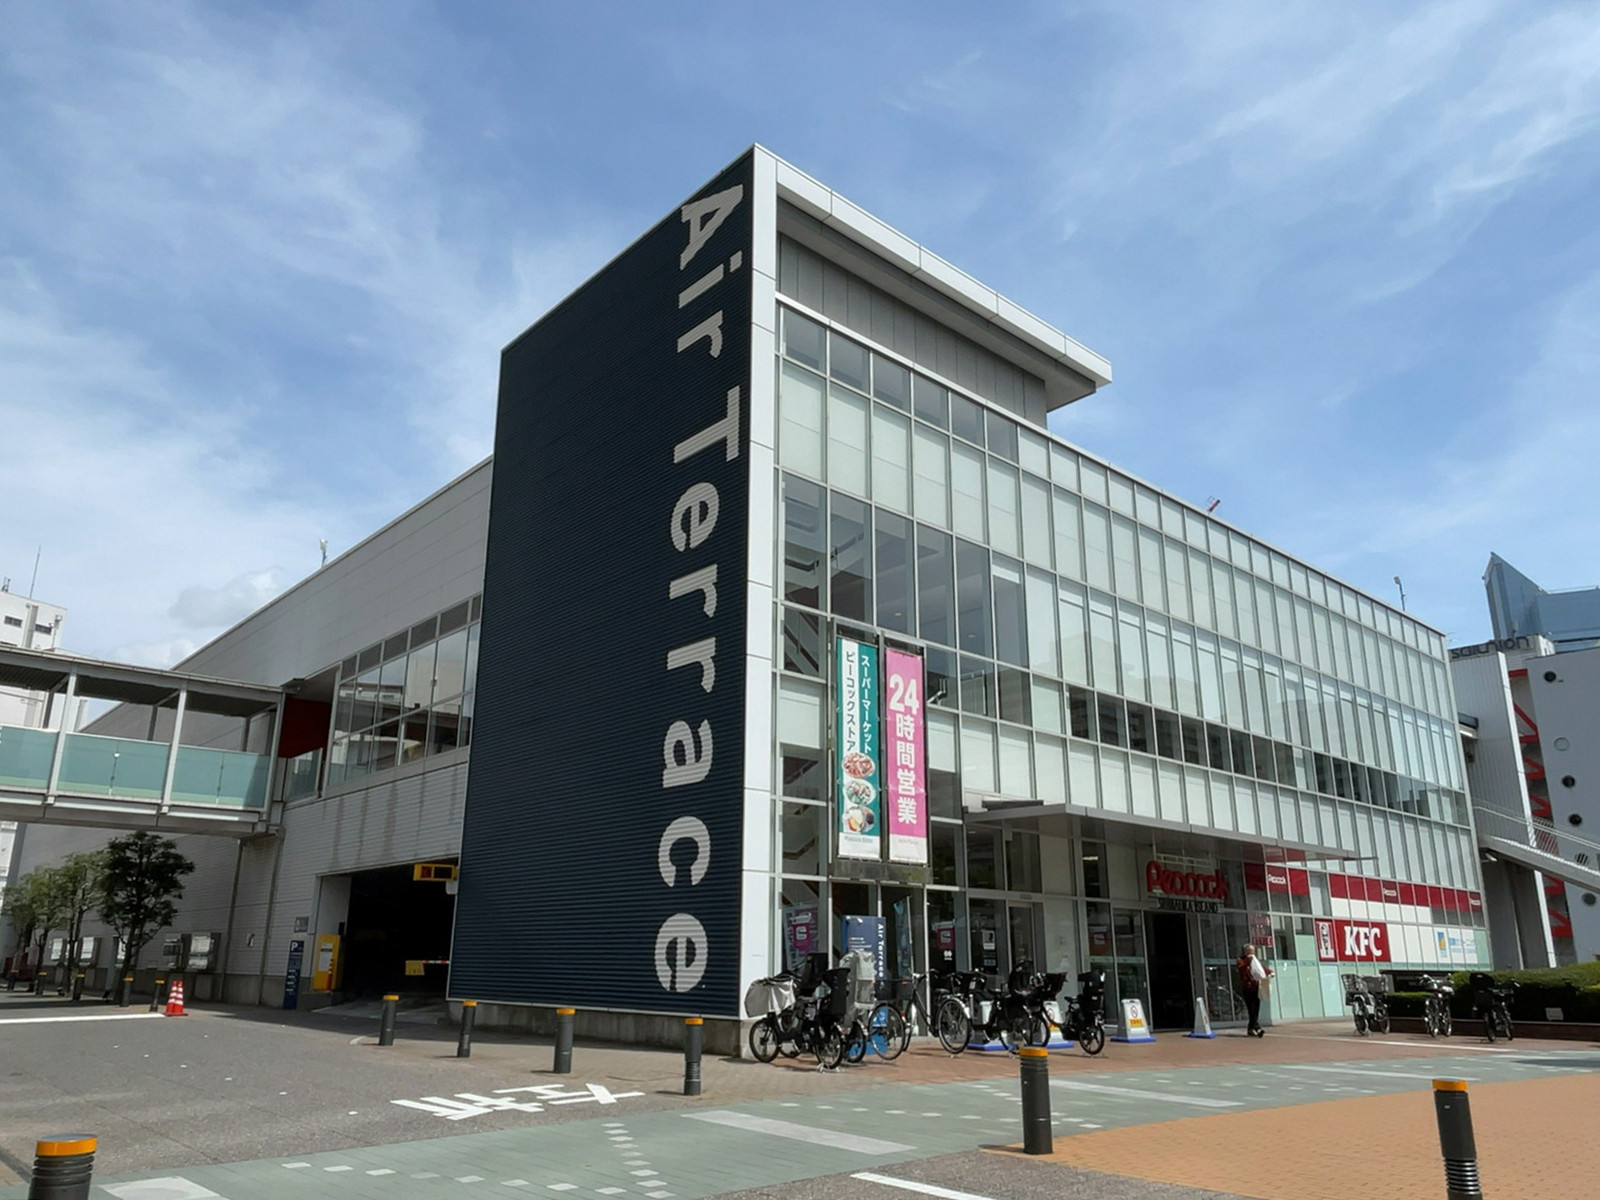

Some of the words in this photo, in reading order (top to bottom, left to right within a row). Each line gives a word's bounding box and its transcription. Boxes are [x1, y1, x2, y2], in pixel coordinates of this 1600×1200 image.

[679, 183, 745, 359] Air
[653, 385, 741, 993] Terrace
[846, 651, 856, 752] ピーコックストア
[861, 655, 872, 754] スーパーマーケット
[889, 673, 920, 826] 24時間営業
[1146, 860, 1230, 900] Peacock
[877, 923, 885, 938] Air
[1344, 925, 1383, 956] KFC
